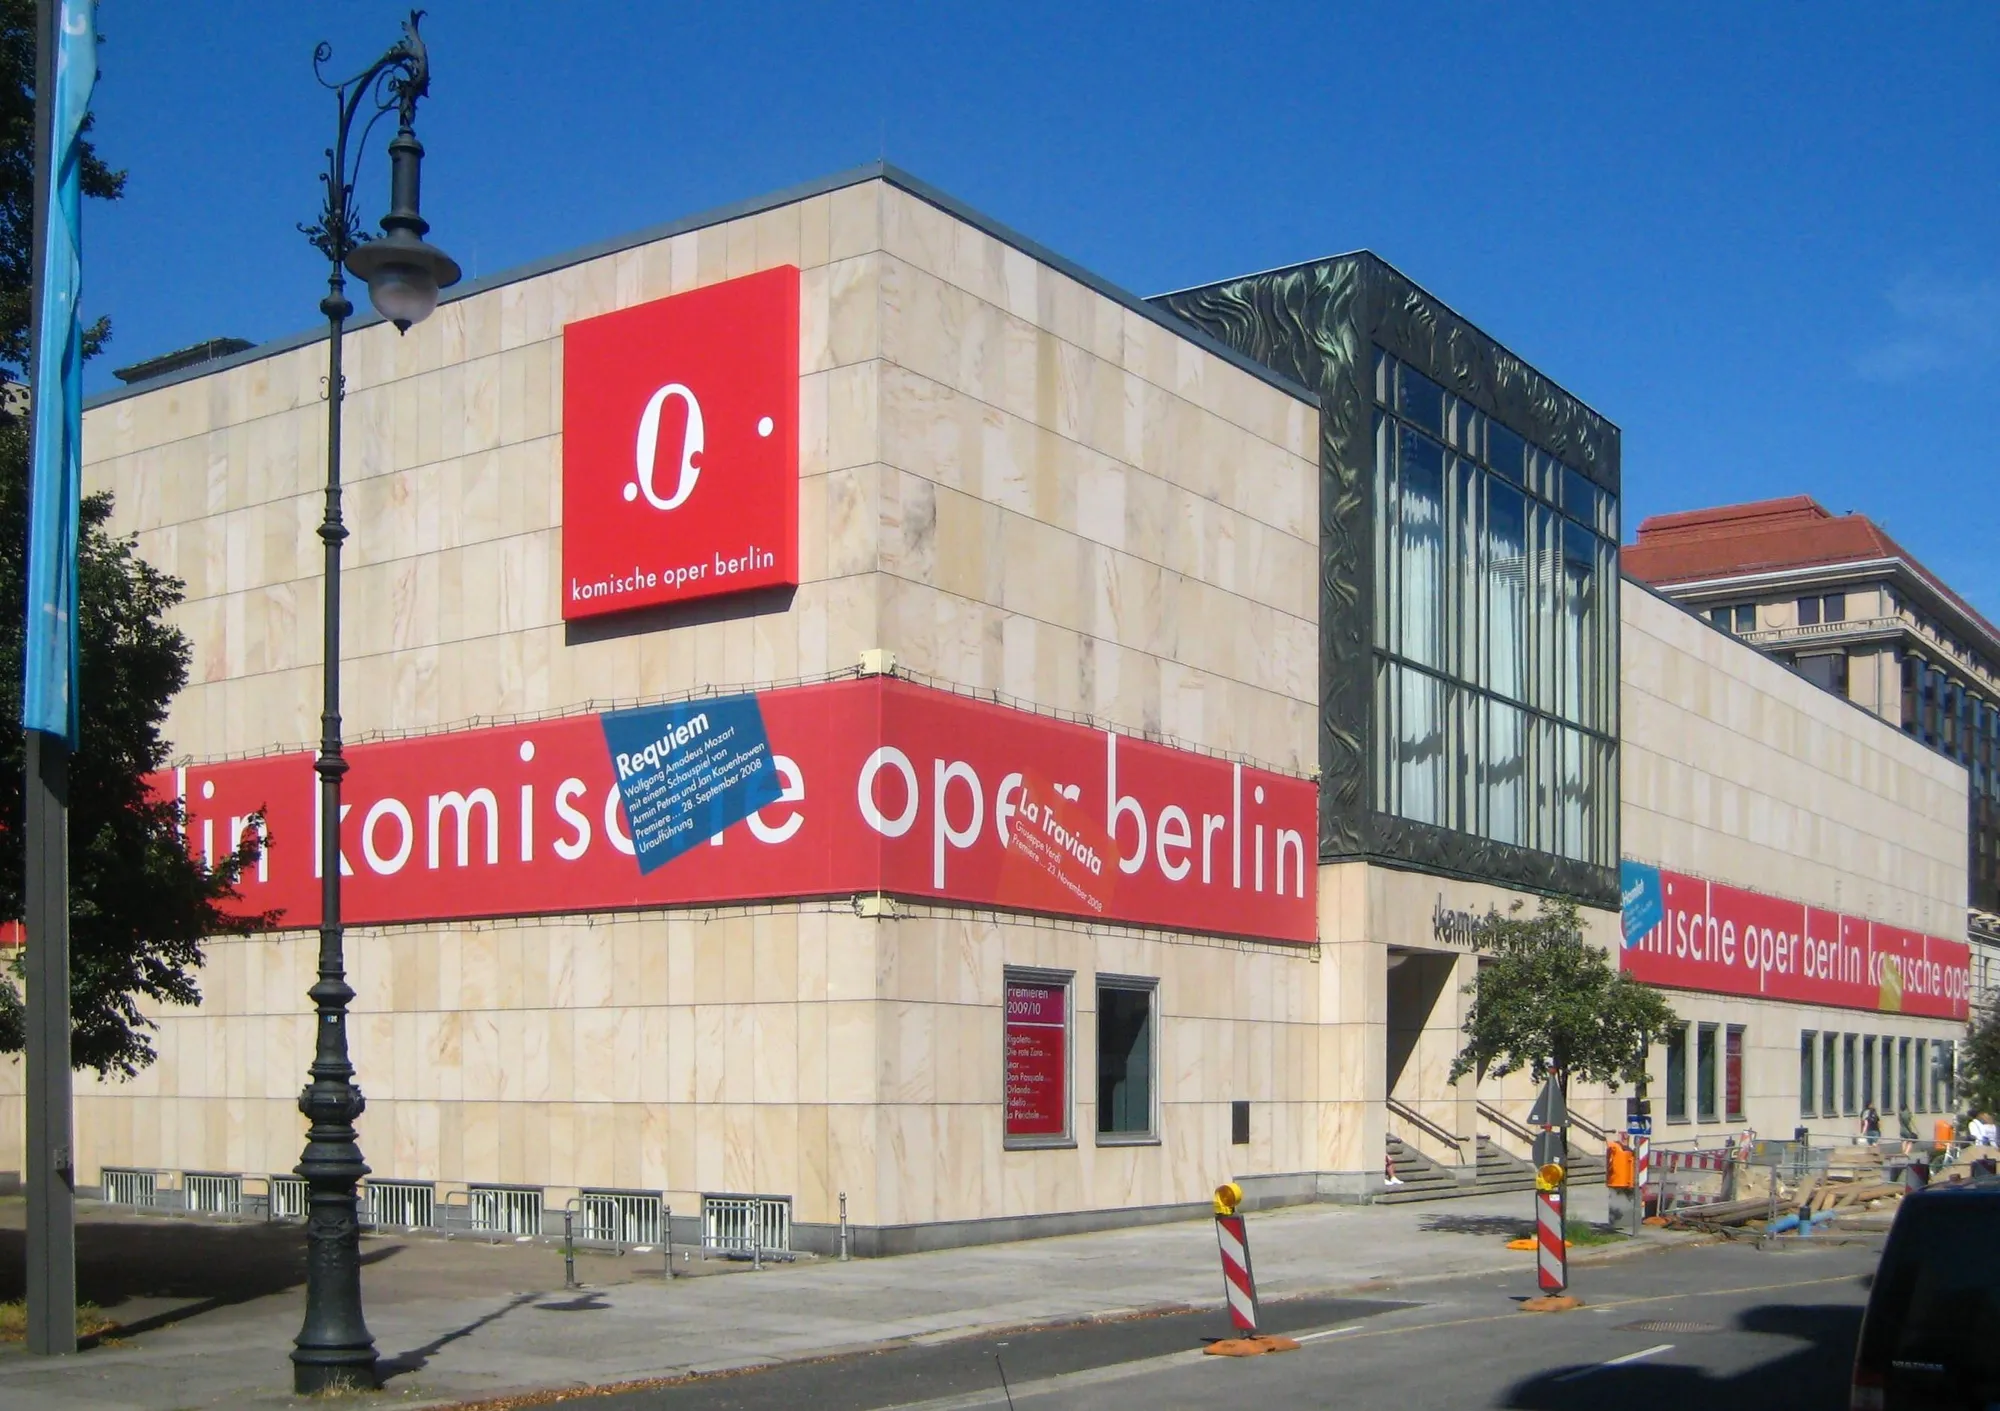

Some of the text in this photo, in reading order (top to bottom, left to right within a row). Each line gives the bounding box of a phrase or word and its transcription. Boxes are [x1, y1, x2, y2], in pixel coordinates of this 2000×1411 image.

[572, 545, 774, 600] komische oper berlin
[616, 713, 709, 781] Requiem
[624, 726, 735, 798] Wolfgang Amadeus Mozart
[629, 748, 727, 813] mit einem Schauspiel von
[314, 740, 804, 878] komisce
[1107, 731, 1304, 898] berlin
[632, 742, 765, 826] Armin Petras und Jan Kauenhowen
[635, 813, 671, 840] Premiere
[682, 800, 696, 813] 28.
[696, 773, 739, 804] September
[740, 758, 763, 779] 2008
[638, 817, 694, 854] Uraufführung
[1019, 787, 1102, 876] La Traviata
[1045, 843, 1062, 864] Verdi
[1012, 833, 1040, 862] Premiere
[1057, 870, 1087, 900] November
[1744, 925, 1799, 992] oper
[1803, 905, 1860, 984] berlin
[1007, 1001, 1041, 1016] 2009/10
